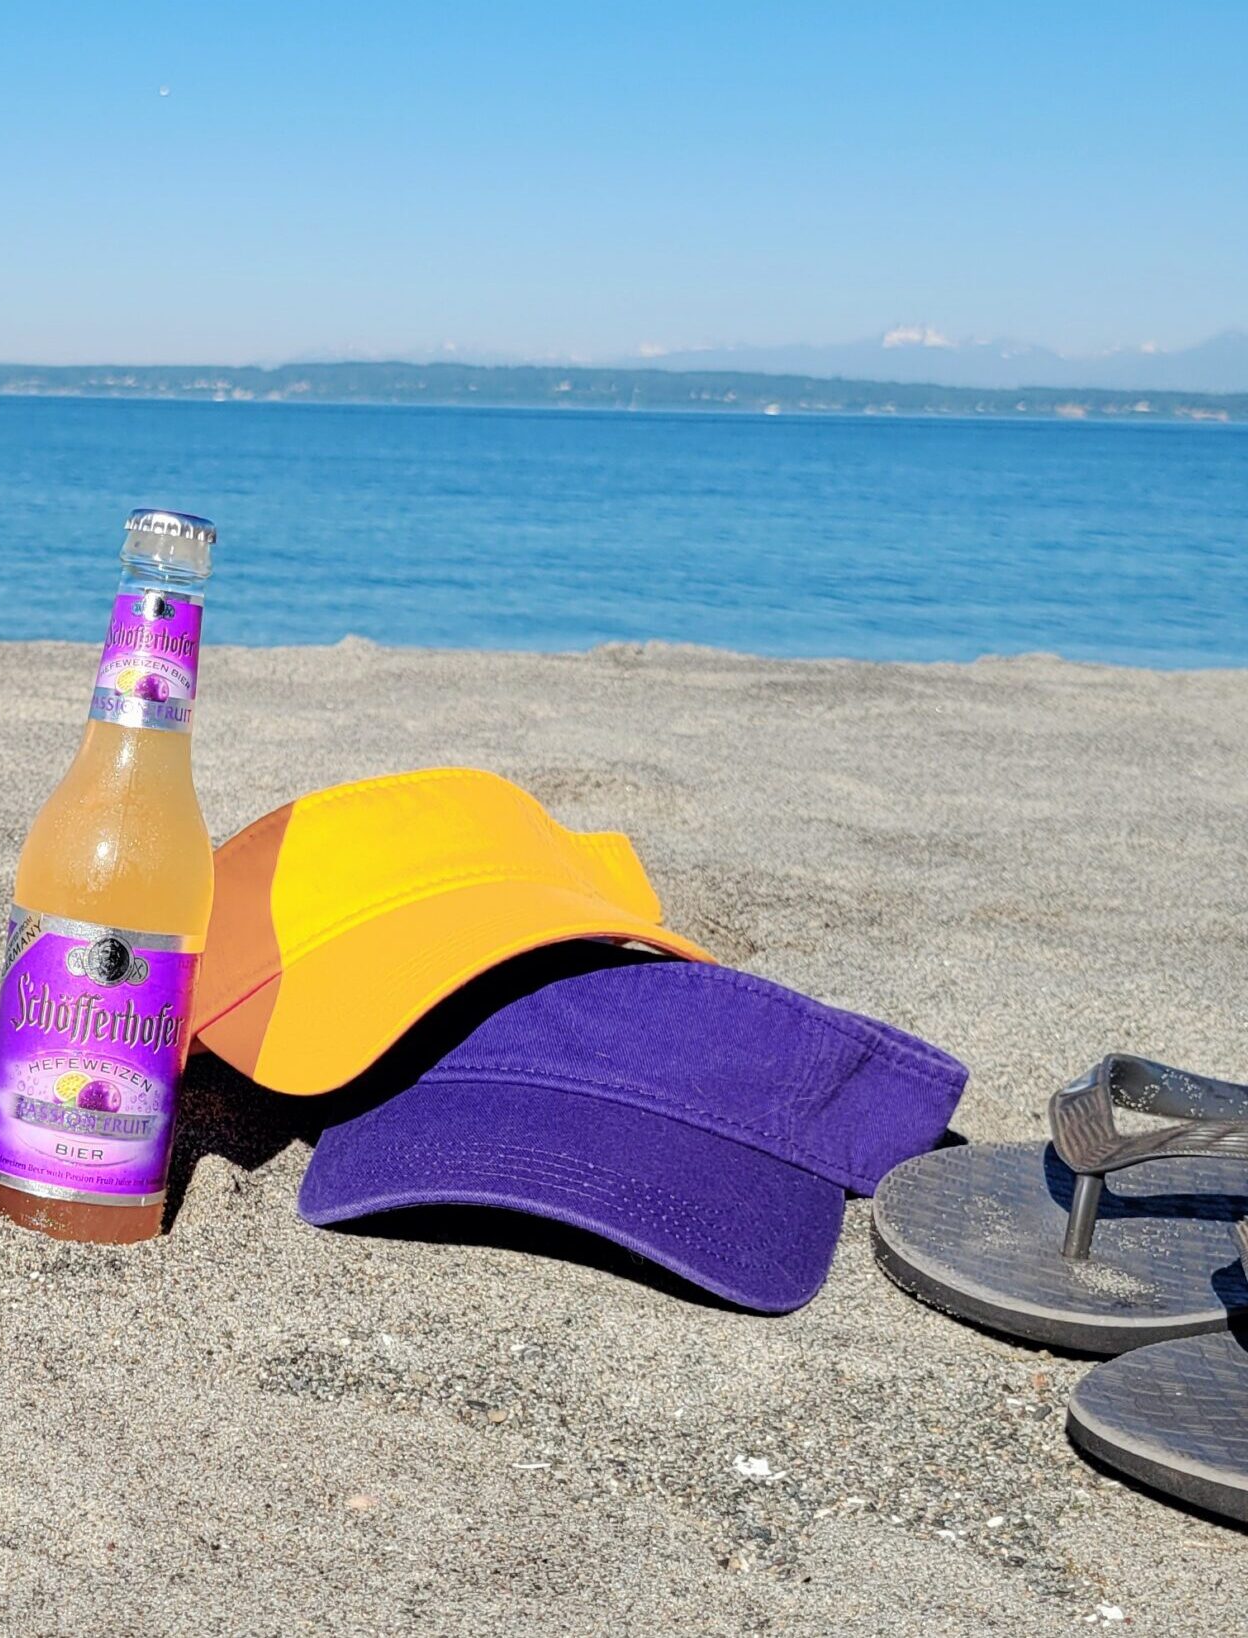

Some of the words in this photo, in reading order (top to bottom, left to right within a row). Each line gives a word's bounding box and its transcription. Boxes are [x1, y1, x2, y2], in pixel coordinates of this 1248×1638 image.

[170, 669, 191, 690] BIER
[156, 706, 192, 723] FRUIT
[11, 971, 184, 1055] Schöfferhofer
[29, 1058, 153, 1093] HEFEWEIZEN
[19, 1099, 96, 1127] PASSION
[103, 1116, 151, 1134] FRUIT
[55, 1143, 103, 1160] BIER
